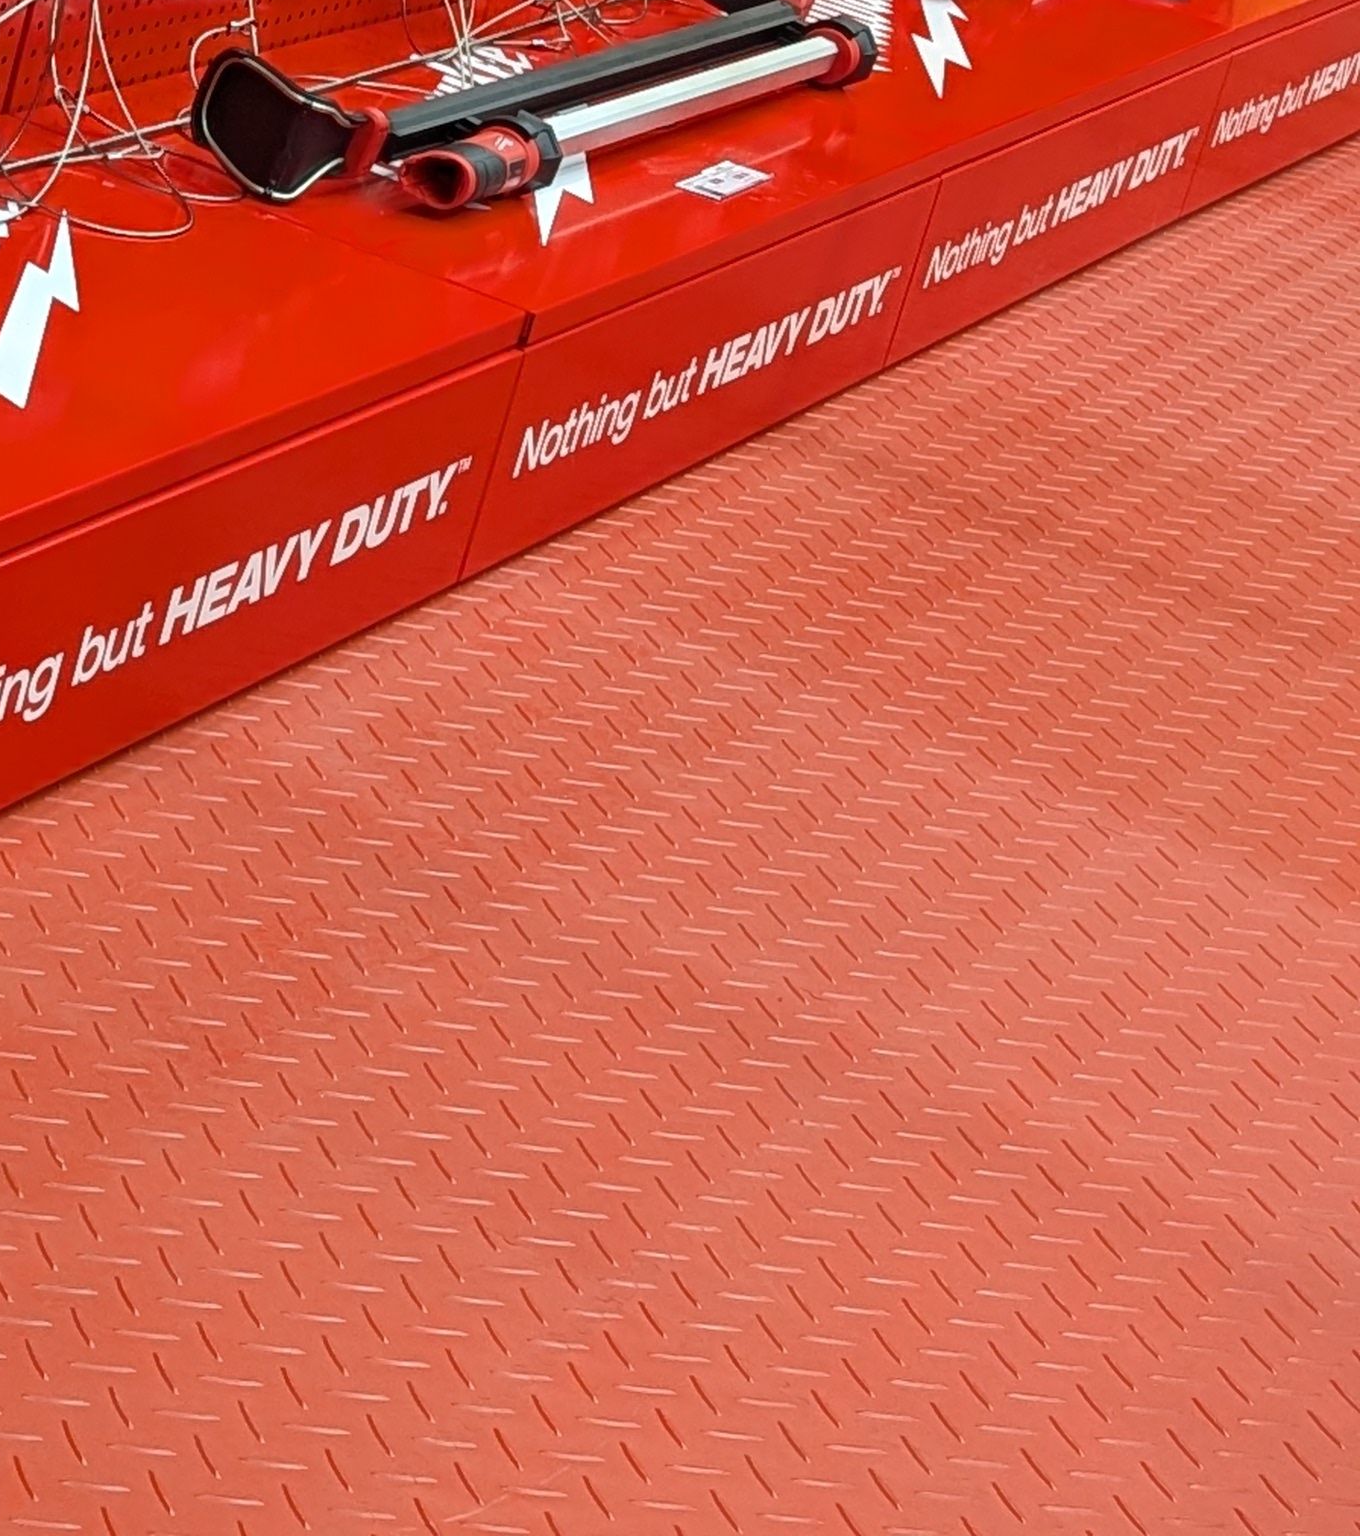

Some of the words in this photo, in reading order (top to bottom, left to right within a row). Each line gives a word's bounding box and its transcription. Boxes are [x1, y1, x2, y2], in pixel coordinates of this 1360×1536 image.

[1210, 94, 1279, 148] Nothing
[1277, 75, 1310, 118] but
[923, 216, 1014, 289] Nothing
[1015, 196, 1053, 247] but
[1053, 162, 1130, 231] HEAVY
[513, 387, 643, 478] Nothing
[645, 360, 697, 417] but
[698, 312, 803, 396] HEAVY
[72, 601, 153, 686] but
[159, 519, 331, 644] HEAVY
